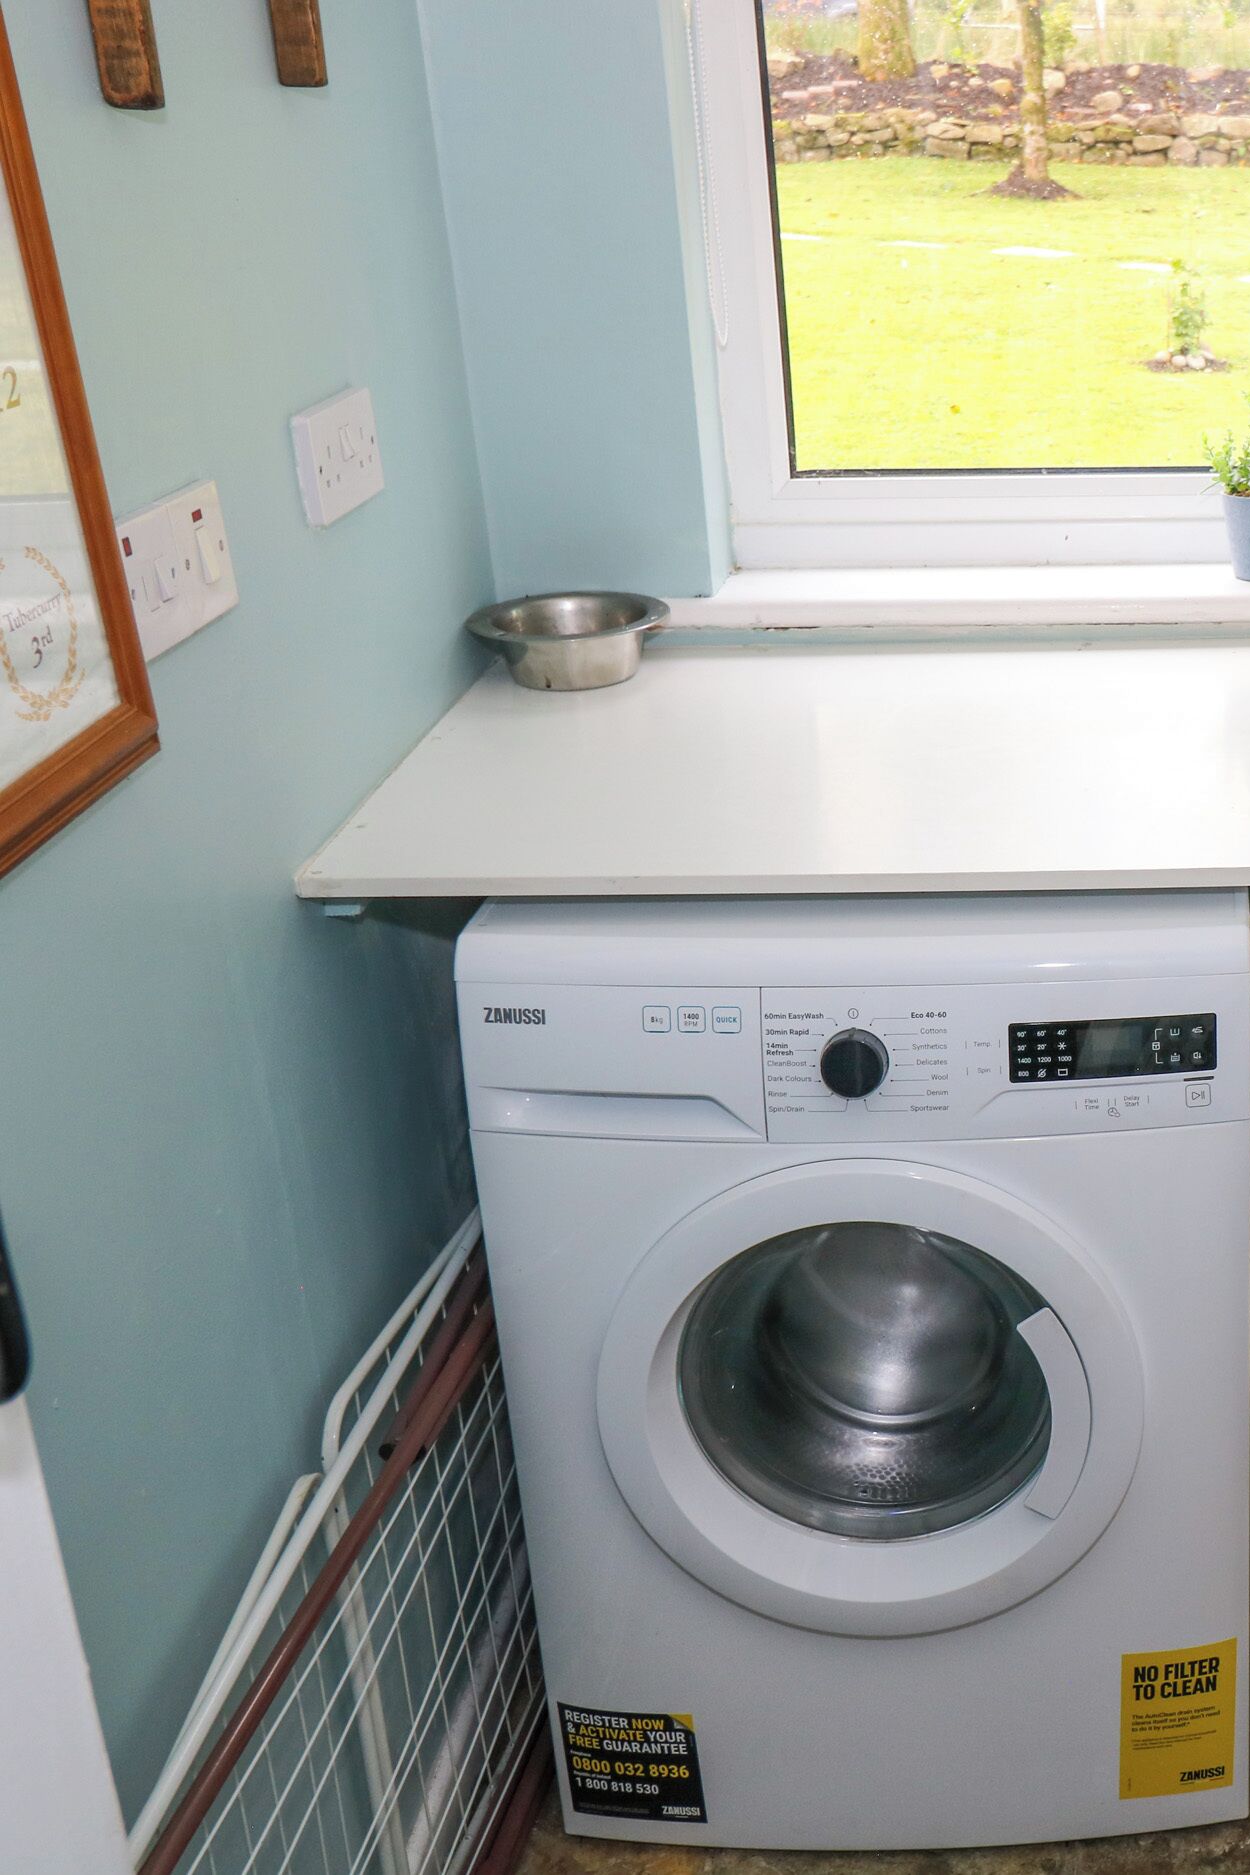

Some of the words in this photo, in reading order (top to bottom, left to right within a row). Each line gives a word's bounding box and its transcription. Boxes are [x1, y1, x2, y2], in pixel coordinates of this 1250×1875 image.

[0, 365, 21, 411] 2
[31, 624, 54, 669] 3rd
[483, 1006, 546, 1025] ZANUSSI
[716, 1016, 738, 1024] QUICK
[764, 1012, 787, 1020] 60min
[788, 1012, 824, 1021] EasyWash
[925, 1011, 947, 1019] 40-60
[789, 1028, 810, 1038] Rapid
[920, 1027, 948, 1035] Cottons
[912, 1043, 948, 1051] Synthetics
[916, 1058, 948, 1066] Delicates
[1017, 1057, 1031, 1065] 1400
[1018, 1070, 1030, 1078] 800
[1123, 1095, 1140, 1103] Delay
[768, 1105, 805, 1113] Spin/Drain
[910, 1105, 949, 1113] Sportswear
[1133, 1665, 1159, 1684] NO
[1164, 1656, 1220, 1681] FILTER
[1132, 1683, 1155, 1701] TO
[1160, 1674, 1217, 1699] CLEAN
[1144, 1711, 1177, 1720] AutoClean
[1194, 1705, 1216, 1714] system
[1152, 1717, 1168, 1725] itself
[1177, 1716, 1189, 1724] you
[1205, 1710, 1221, 1718] need
[564, 1709, 629, 1729] REGISTER
[632, 1718, 664, 1730] NOW
[567, 1721, 576, 1734] &
[579, 1724, 645, 1742] ACTIVATE
[646, 1731, 686, 1743] YOUR
[568, 1734, 600, 1750] FREE
[603, 1739, 688, 1755] GUARANTEE
[572, 1755, 611, 1774] 0800
[615, 1761, 645, 1777] 032
[649, 1764, 690, 1779] 8936
[1180, 1765, 1225, 1782] ZANUSSI
[575, 1777, 582, 1788] 1
[585, 1778, 608, 1791] 800
[611, 1781, 633, 1793] 818
[636, 1783, 659, 1796] 530
[661, 1805, 701, 1817] ZANUSSI
